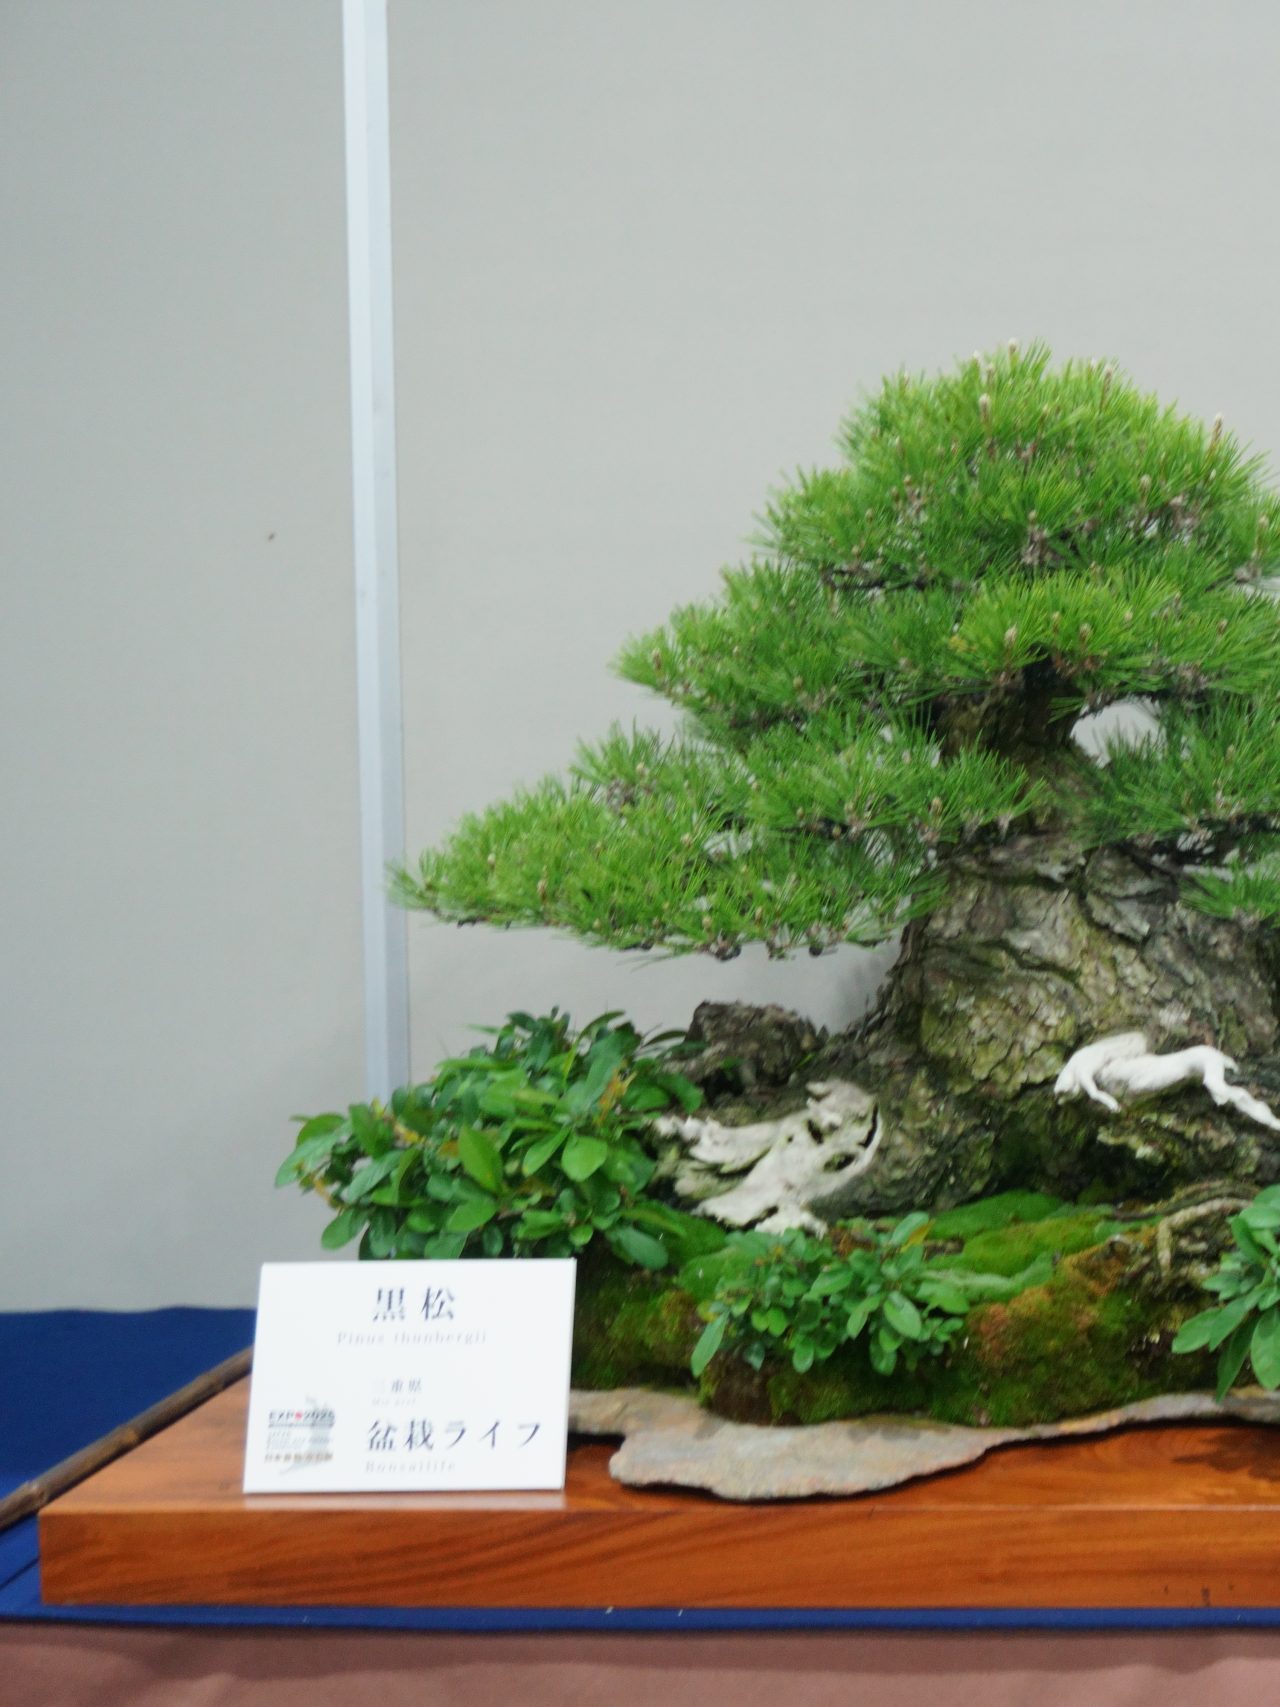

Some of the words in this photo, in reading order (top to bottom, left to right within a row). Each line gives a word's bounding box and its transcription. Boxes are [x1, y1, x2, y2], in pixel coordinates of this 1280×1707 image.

[371, 1285, 456, 1323] 黒松
[336, 1331, 385, 1345] Pinus
[367, 1418, 542, 1452] 盆栽ライフ
